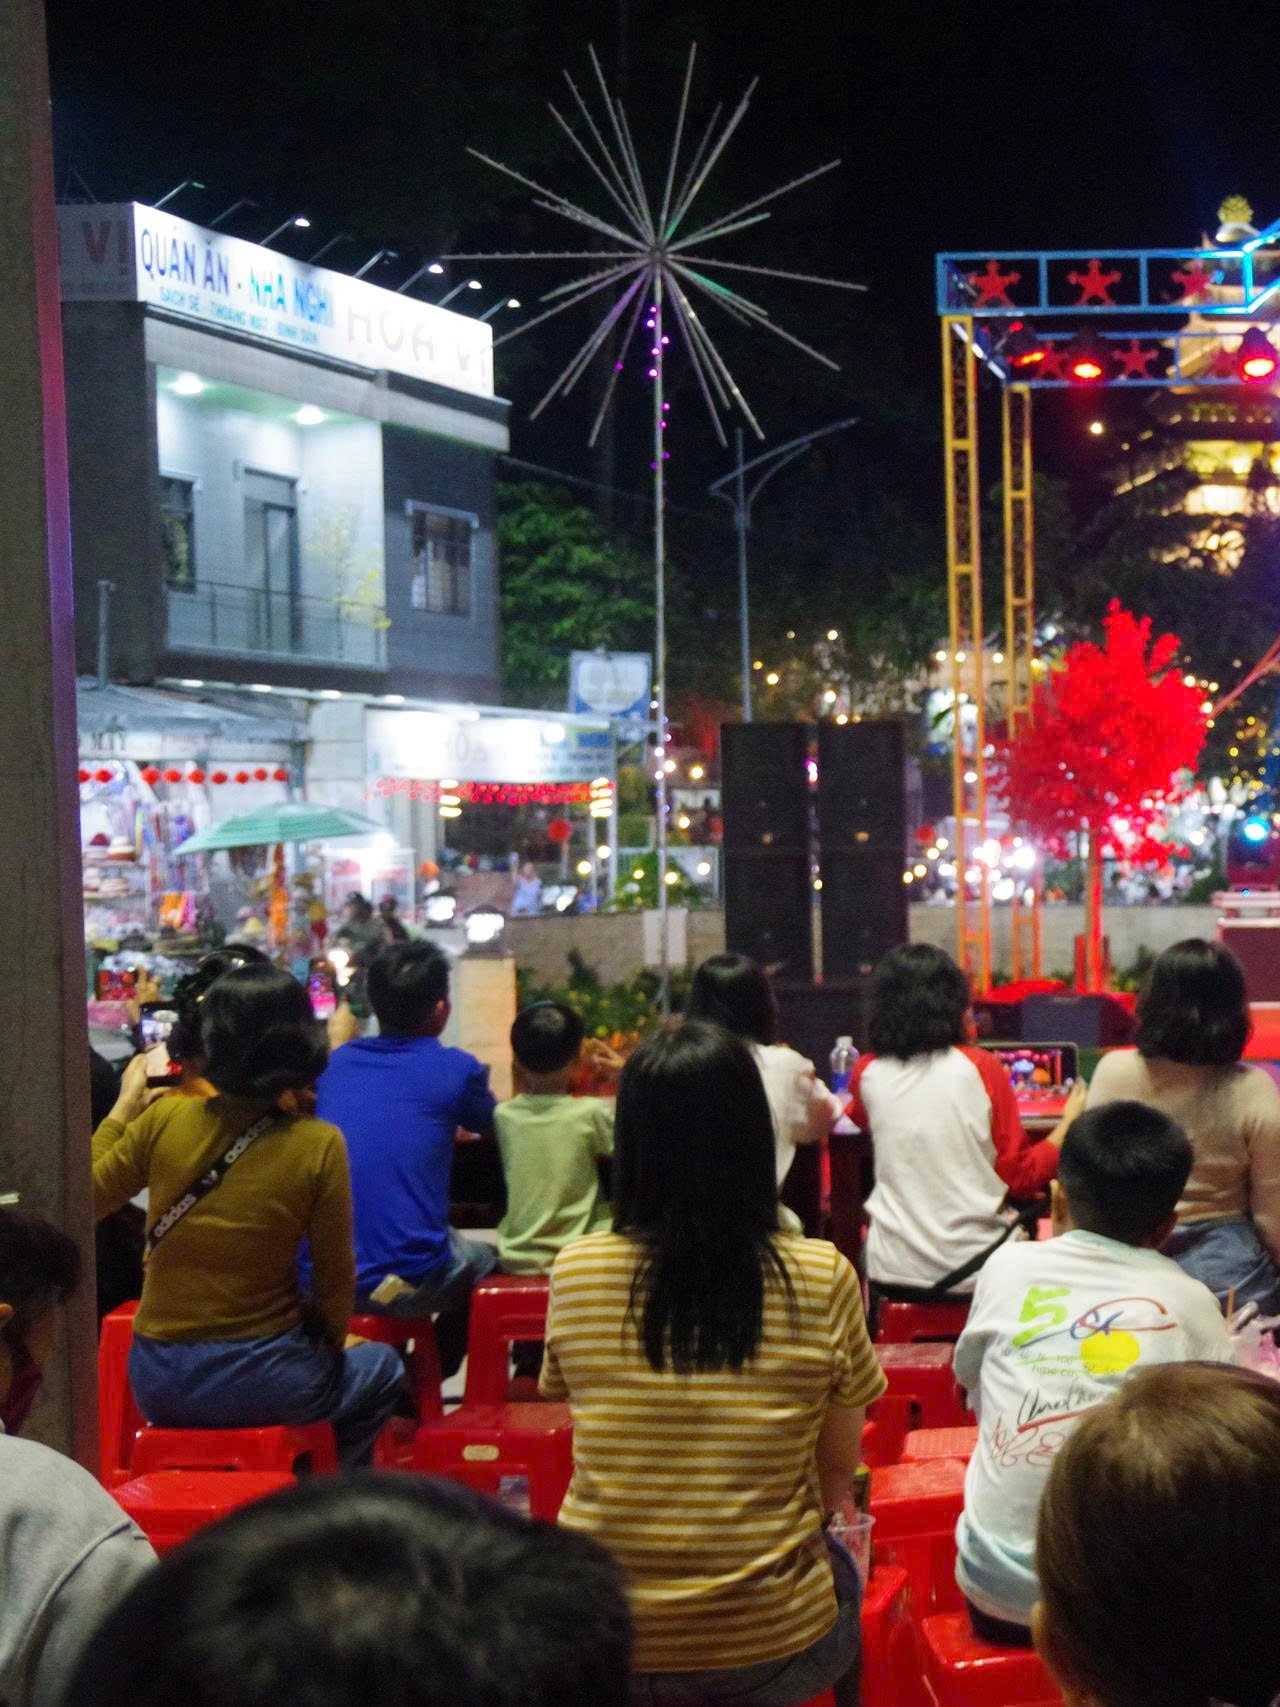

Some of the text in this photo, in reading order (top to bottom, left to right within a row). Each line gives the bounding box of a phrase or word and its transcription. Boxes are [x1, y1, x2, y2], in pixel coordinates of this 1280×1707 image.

[140, 225, 197, 285] QUÁN
[154, 1116, 274, 1238] adidas adidas
